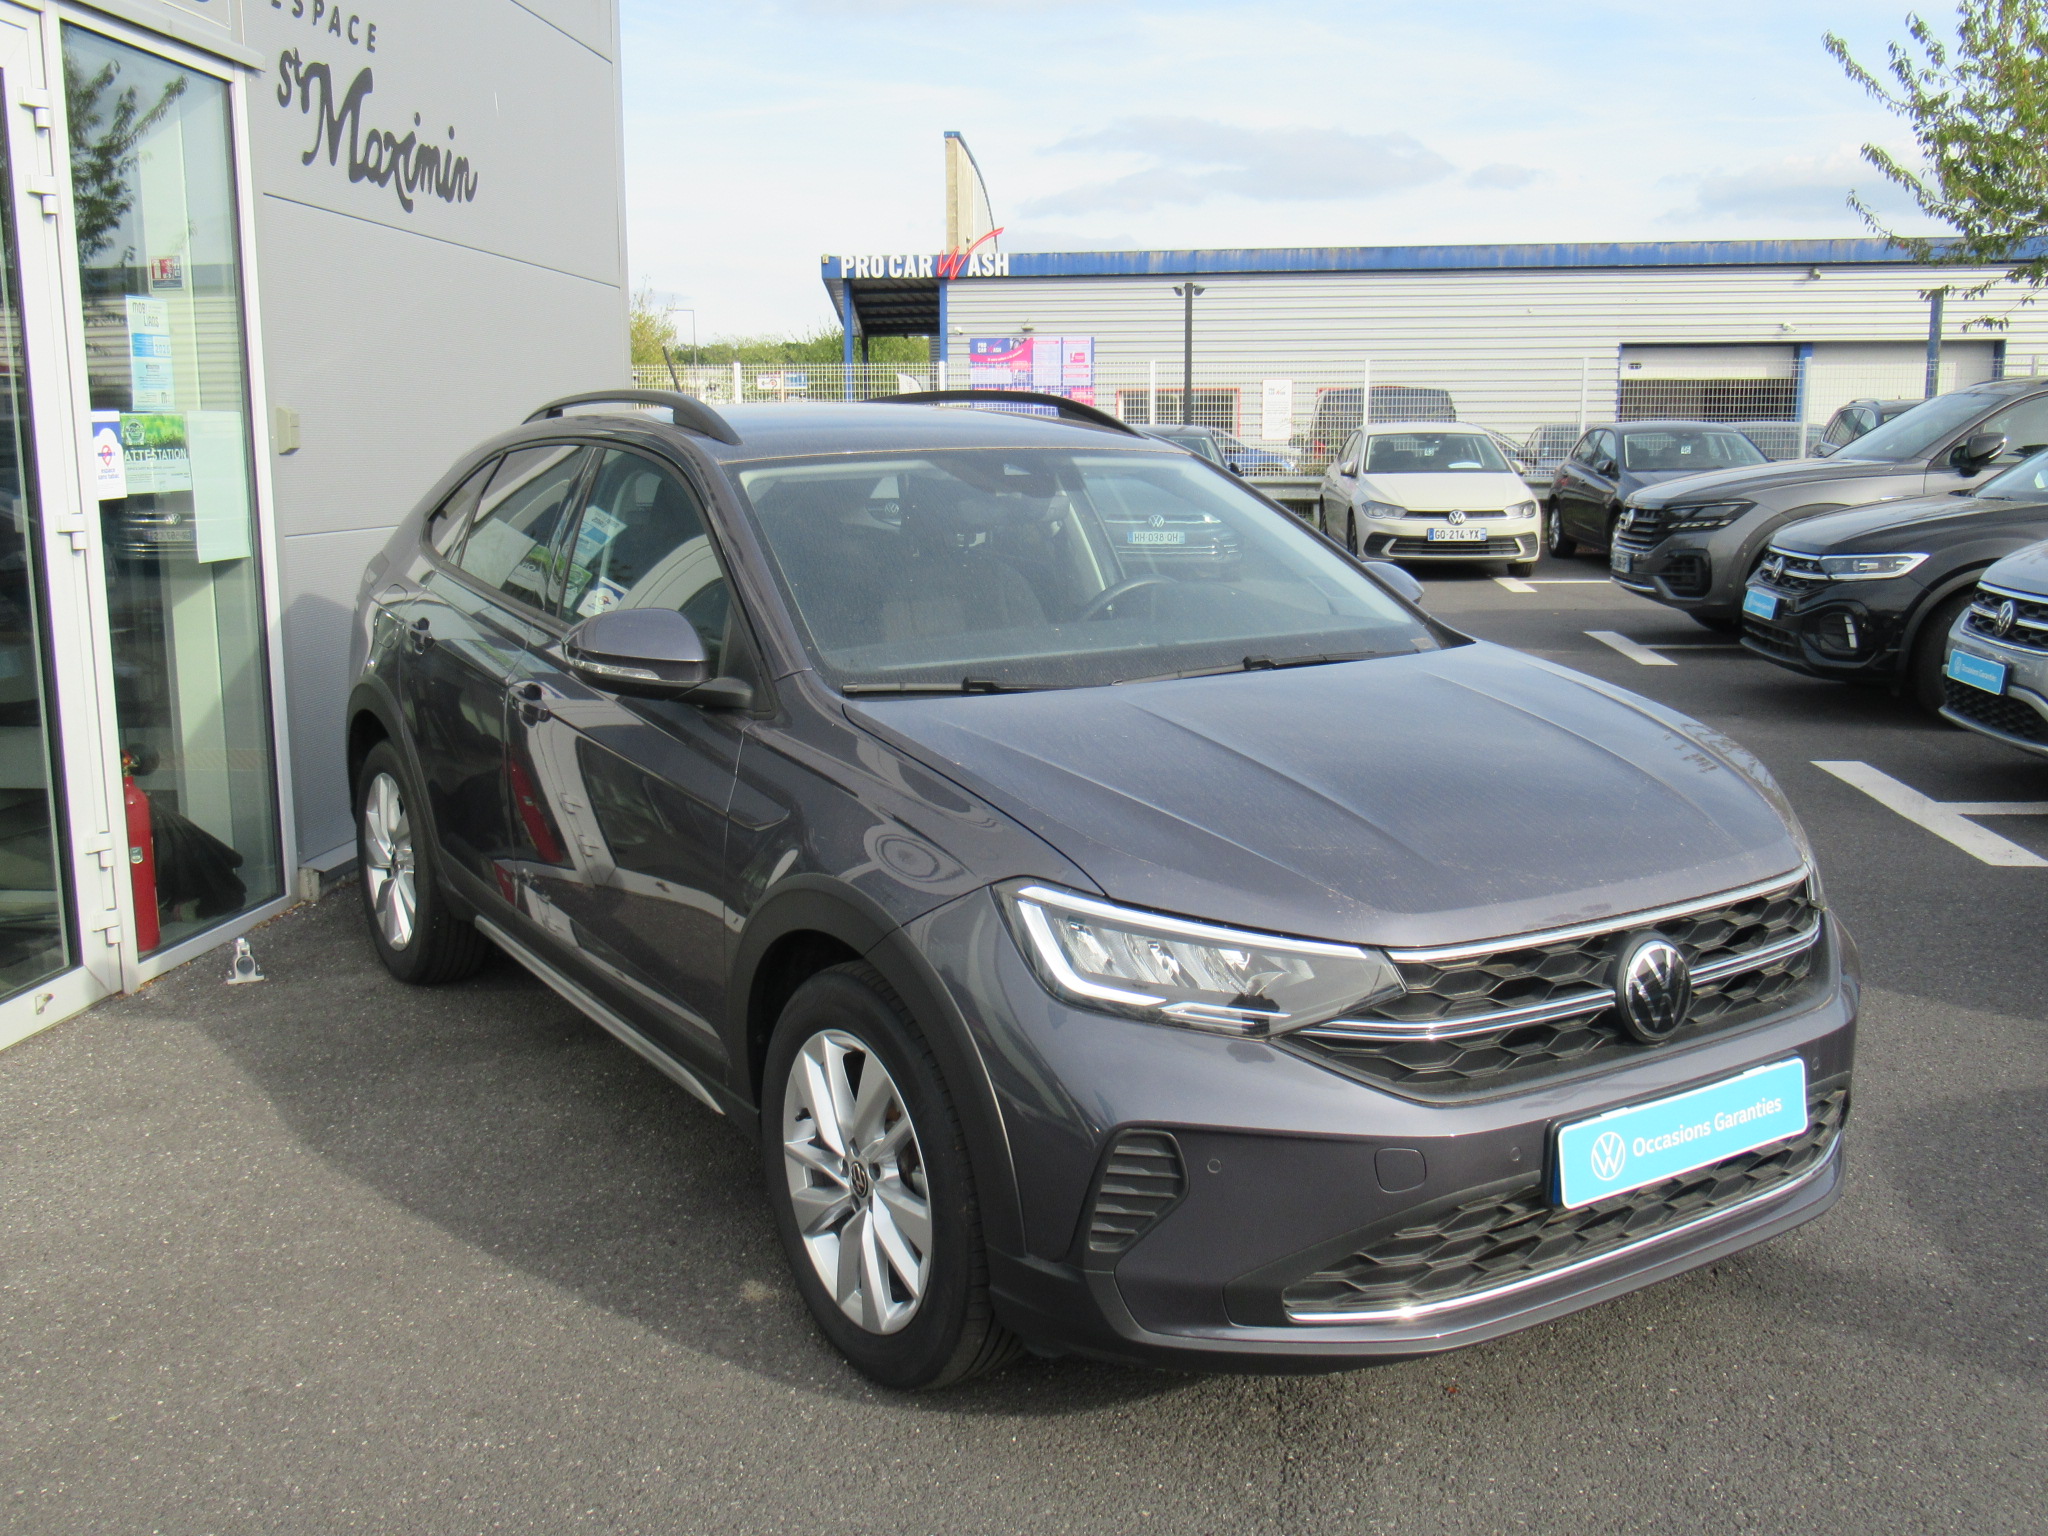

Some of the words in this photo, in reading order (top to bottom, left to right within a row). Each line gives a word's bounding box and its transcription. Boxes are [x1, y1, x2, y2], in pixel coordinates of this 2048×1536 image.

[300, 62, 478, 213] Maximin
[841, 255, 884, 278] PRO
[888, 255, 933, 279] CAR
[936, 227, 1009, 280] WASH
[124, 448, 188, 461] ATTESTATION
[1632, 1119, 1711, 1157] Occasions
[1713, 1097, 1782, 1132] Garanties
